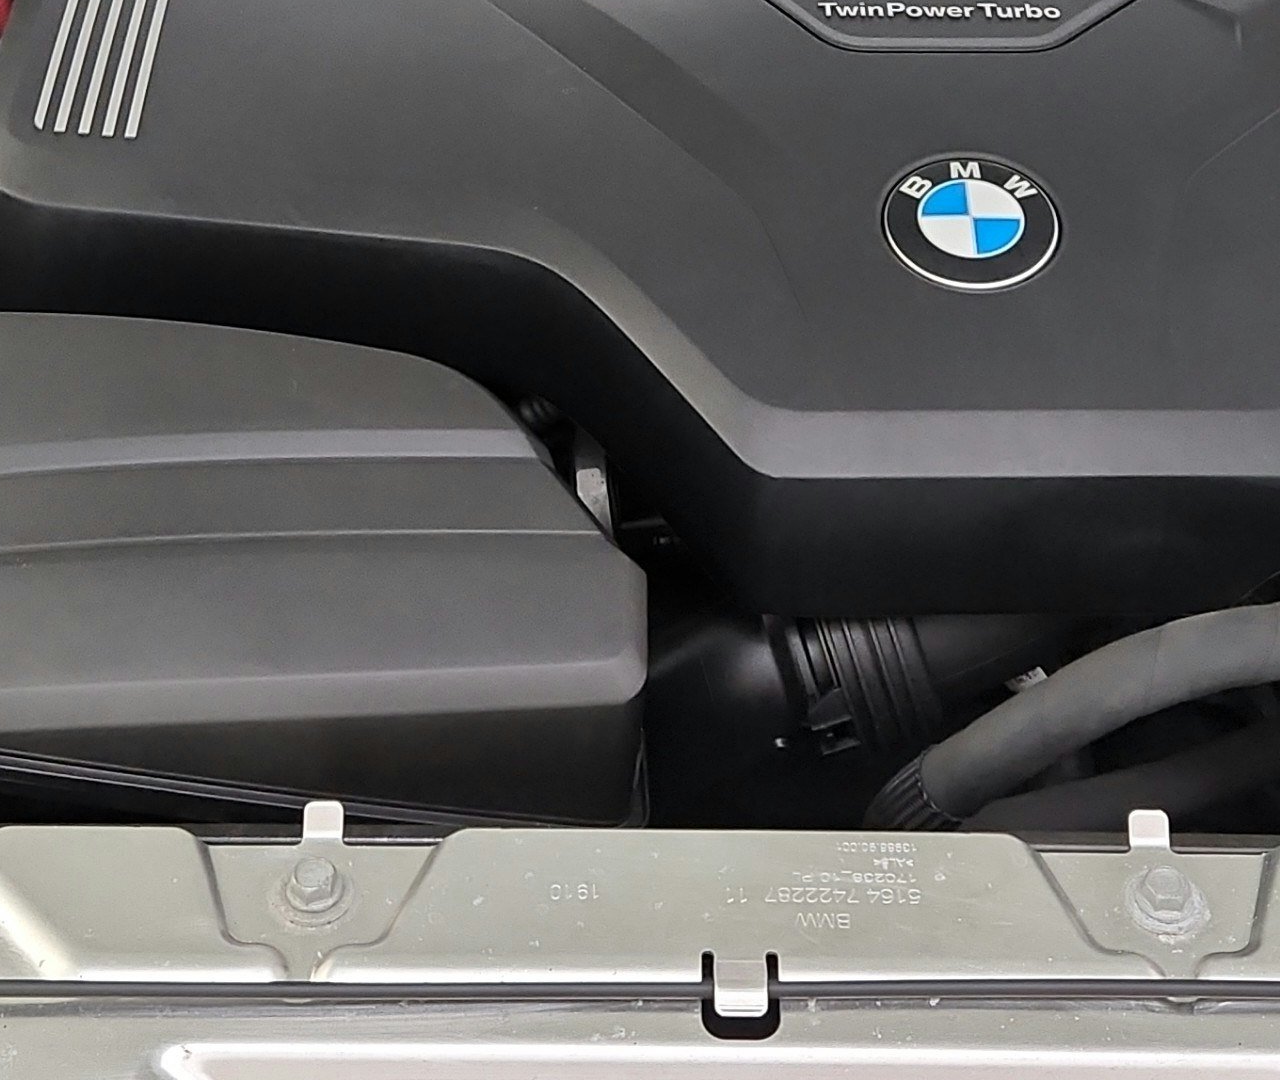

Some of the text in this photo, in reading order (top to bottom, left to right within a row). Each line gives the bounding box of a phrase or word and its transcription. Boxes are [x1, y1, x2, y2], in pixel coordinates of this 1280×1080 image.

[817, 0, 1061, 19] TwinPower Turbo
[899, 161, 1038, 199] BMW
[765, 887, 860, 903] 7422287
[867, 888, 921, 904] 5164
[797, 912, 851, 929] BMW
